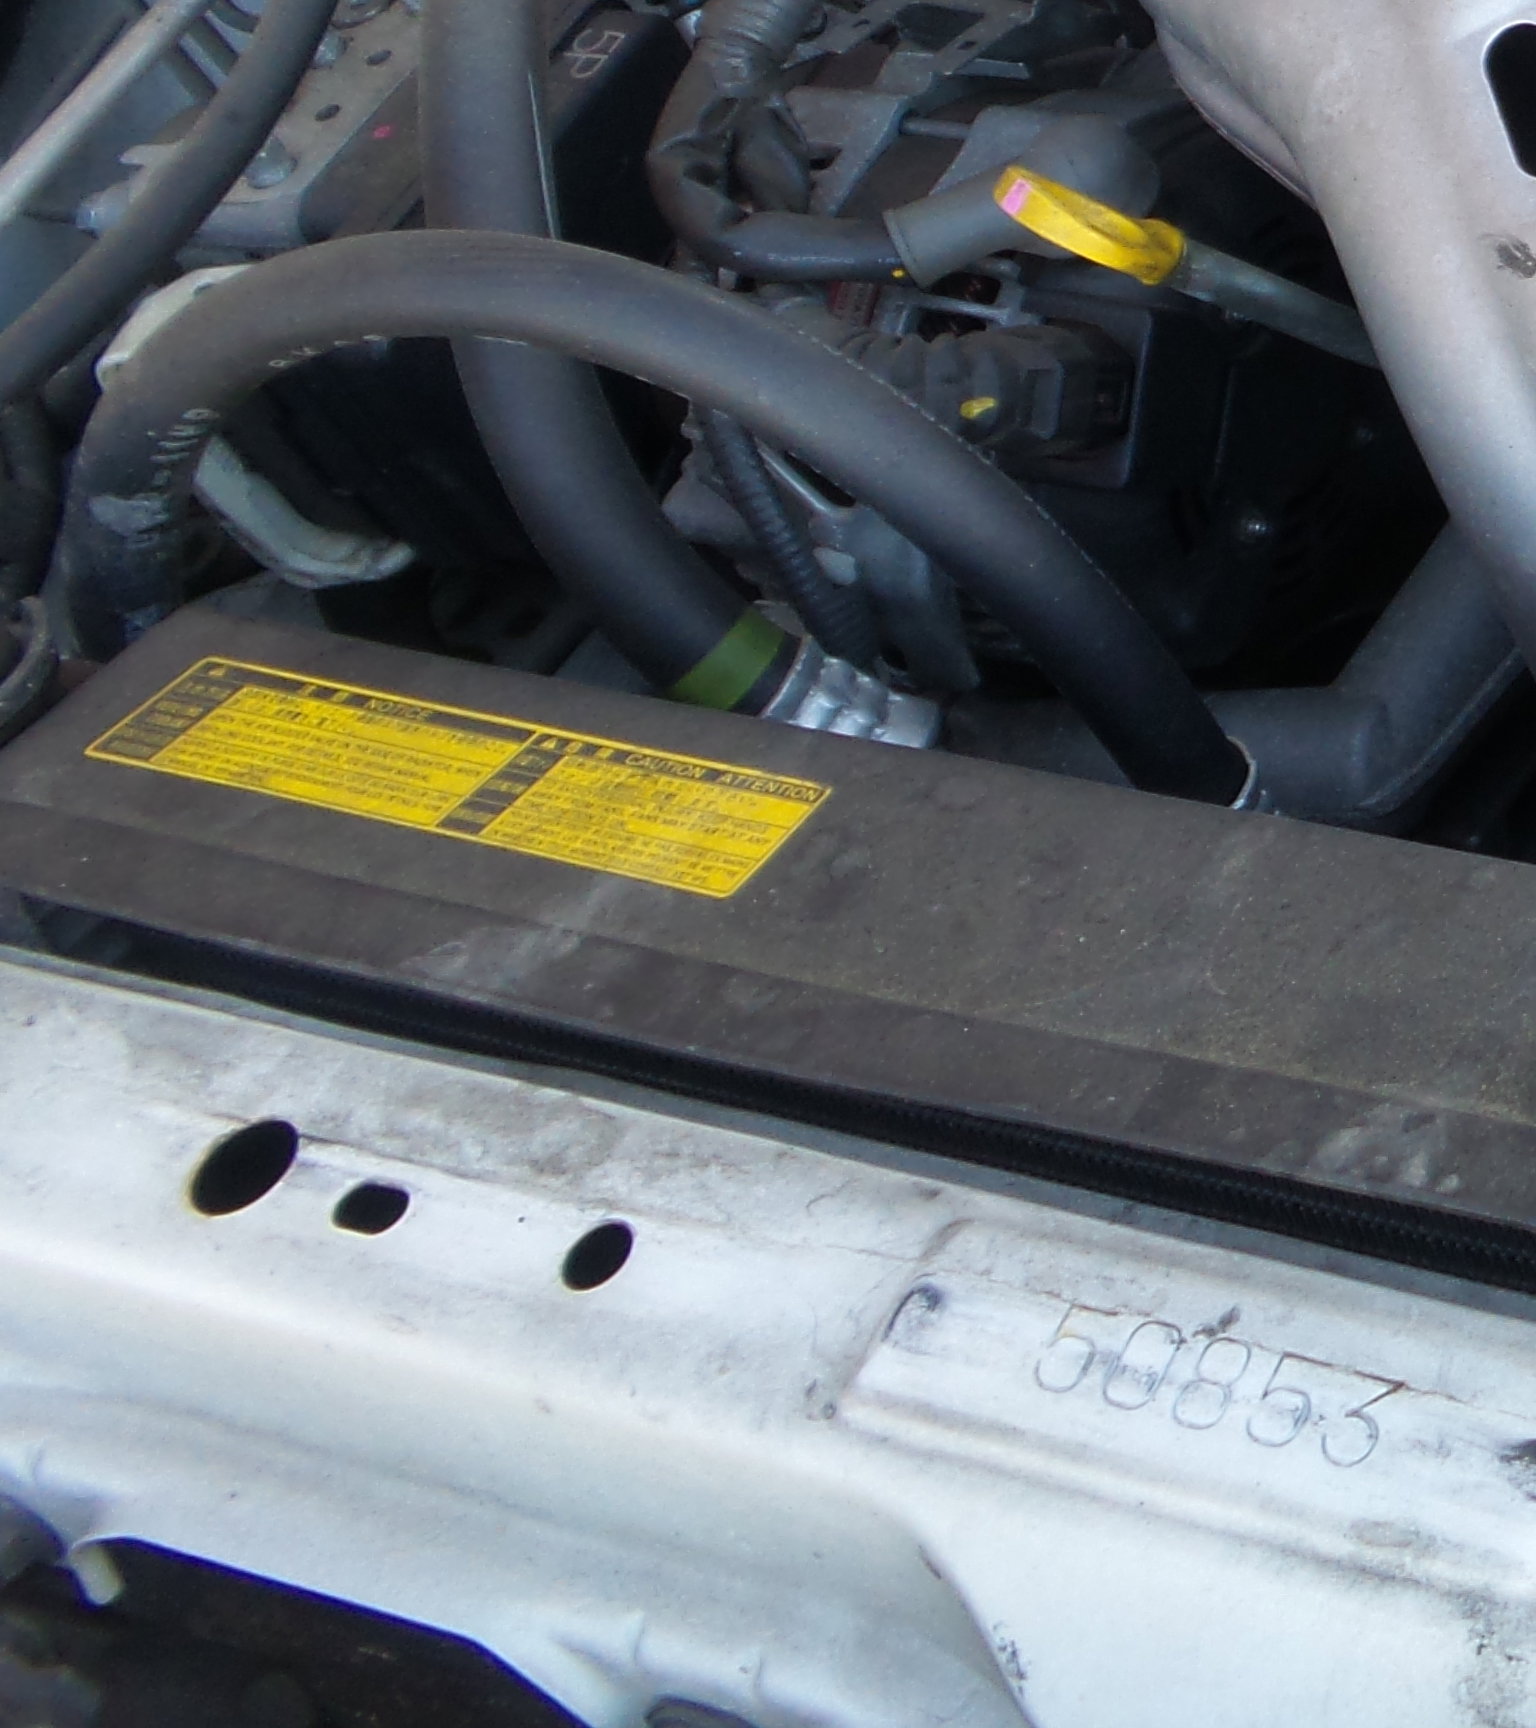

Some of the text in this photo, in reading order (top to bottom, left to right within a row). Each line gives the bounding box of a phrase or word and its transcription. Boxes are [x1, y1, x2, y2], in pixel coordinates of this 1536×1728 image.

[365, 697, 434, 722] NOTICE
[624, 753, 706, 780] CAUTION
[714, 772, 818, 803] ATTENTION
[1033, 1299, 1406, 1469] 50853
